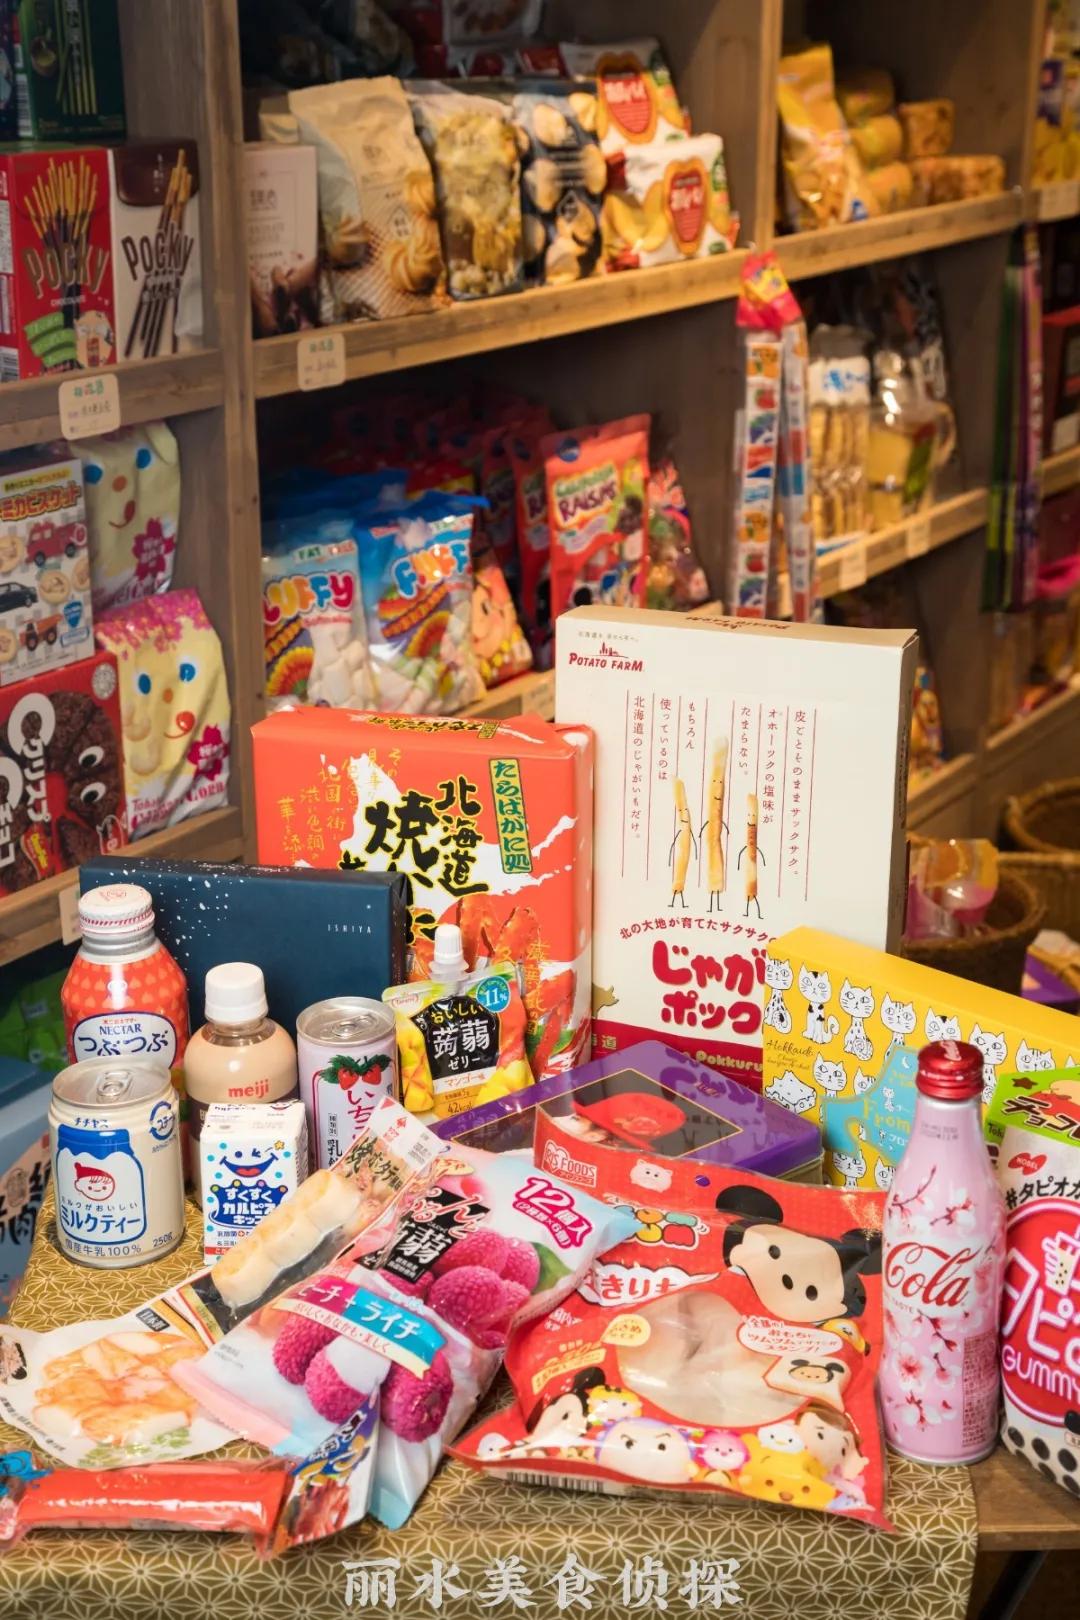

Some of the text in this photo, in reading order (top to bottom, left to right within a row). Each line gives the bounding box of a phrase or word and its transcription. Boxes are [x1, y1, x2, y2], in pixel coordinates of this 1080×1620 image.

[569, 652, 643, 673] POTATO FARM
[658, 698, 672, 780] 使っているのは
[685, 701, 696, 750] もちろん
[739, 706, 751, 776] たまらない。
[631, 696, 645, 839] 北海道のじゃがいもだけ。
[762, 708, 778, 824] オホーツクの塩味が
[434, 776, 490, 897] 北海道
[494, 762, 531, 872] たらばがに処
[328, 924, 372, 934] ISHIYA
[652, 940, 766, 997] じゃが
[99, 1023, 142, 1036] NECTAR
[431, 1002, 485, 1024] おいしい
[661, 990, 762, 1034] ポック
[78, 1030, 169, 1057] つぶつぶ
[433, 1018, 490, 1060] 蒟蒻
[448, 1054, 481, 1071] ゼリー
[228, 1078, 270, 1099] meiji
[560, 1158, 596, 1177] FOODS
[1016, 1156, 1039, 1171] NOBEL
[224, 1187, 273, 1203] すくすく
[61, 1205, 141, 1234] ミルクティー
[885, 1241, 976, 1307] Cola
[361, 1301, 422, 1340] ライチ
